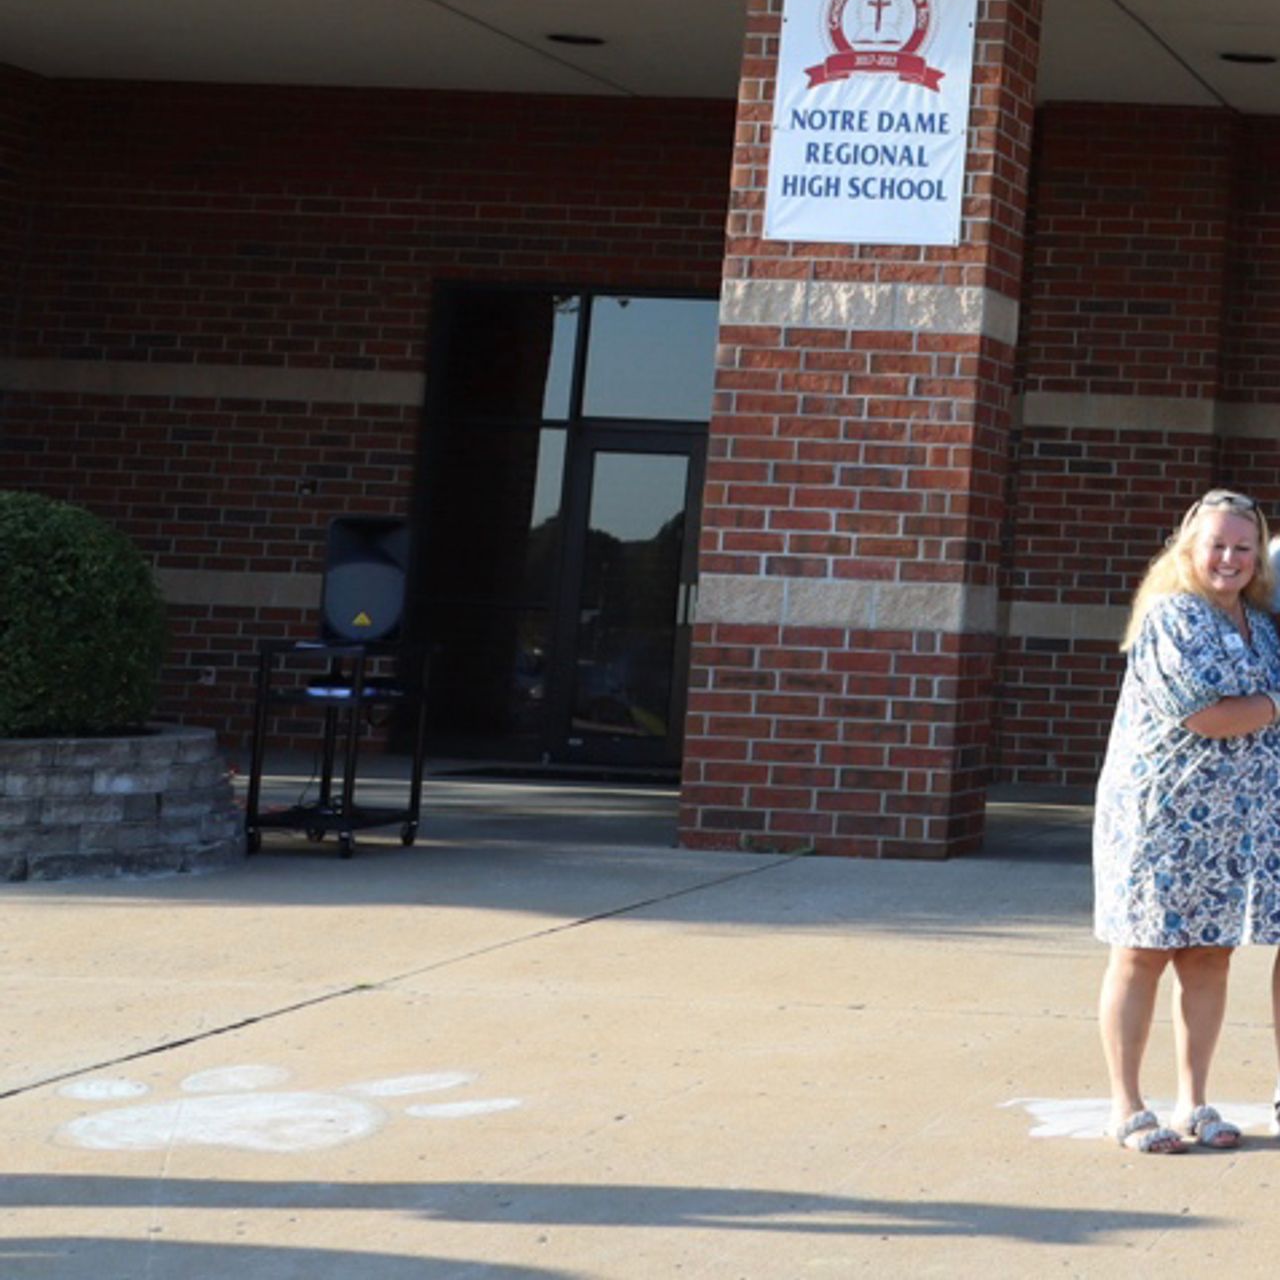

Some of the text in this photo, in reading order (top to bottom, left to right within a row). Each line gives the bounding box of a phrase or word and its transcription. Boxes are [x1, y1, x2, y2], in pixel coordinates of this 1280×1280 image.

[791, 109, 949, 134] NOTRE DAME
[805, 142, 929, 167] REGIONAL
[782, 175, 947, 201] HIGH SCHOOL
